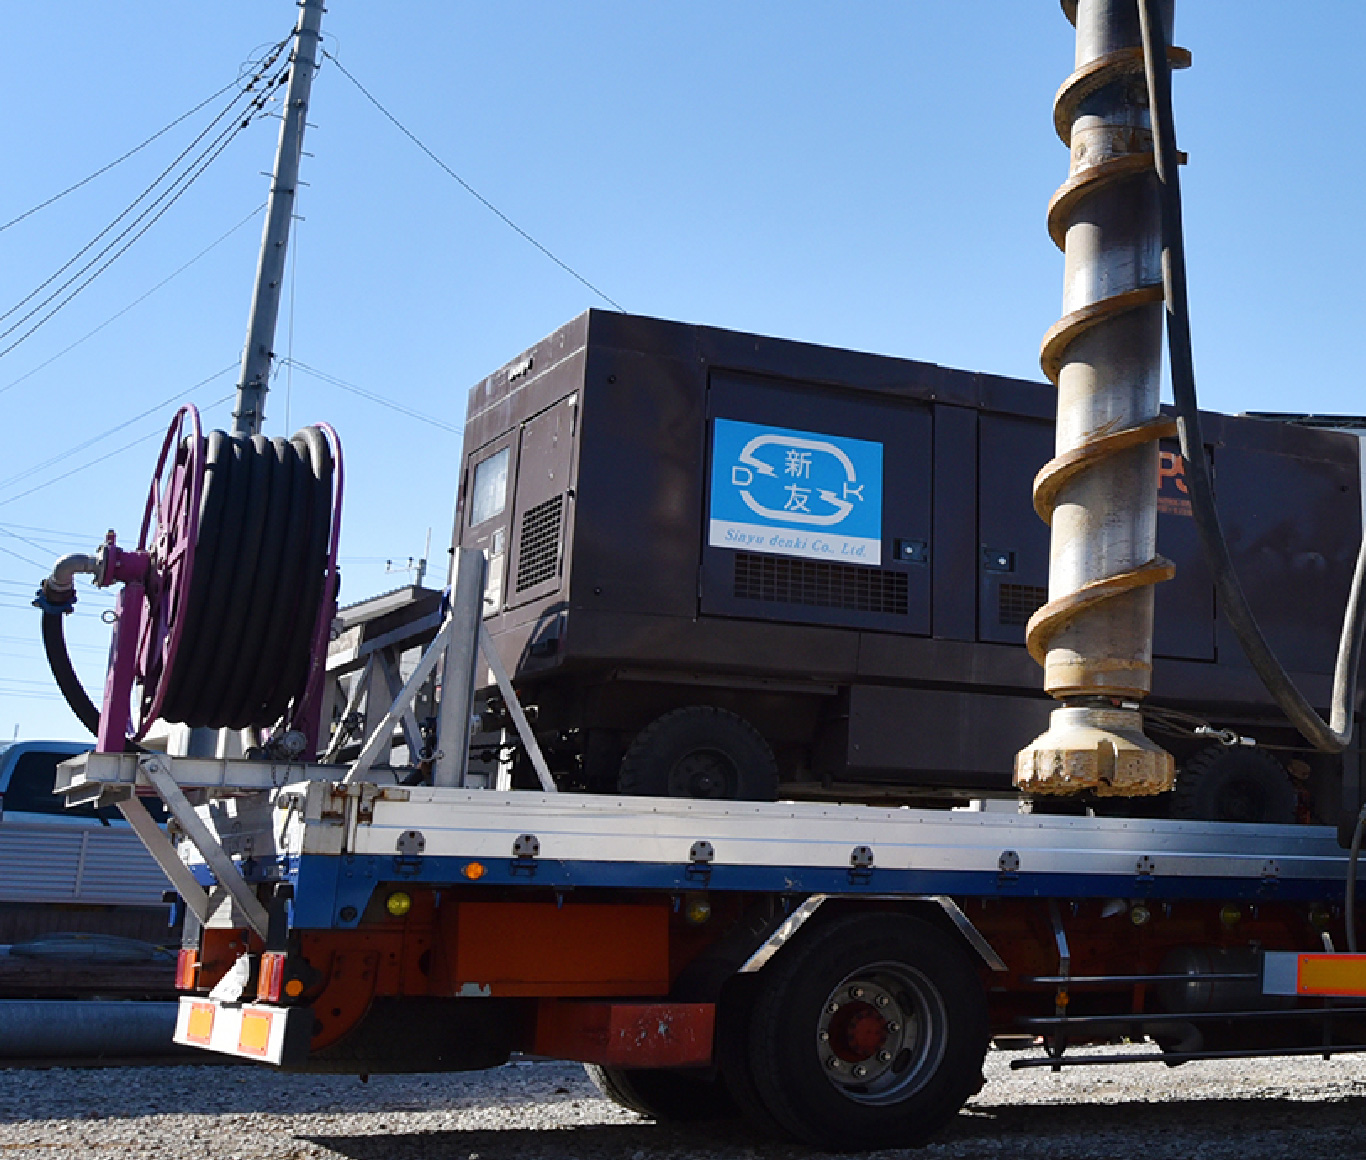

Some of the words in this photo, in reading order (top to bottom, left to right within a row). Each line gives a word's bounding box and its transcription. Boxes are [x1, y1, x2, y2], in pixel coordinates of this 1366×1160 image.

[784, 448, 812, 513] 新友
[725, 527, 765, 546] Sinyu
[769, 534, 808, 549] denki
